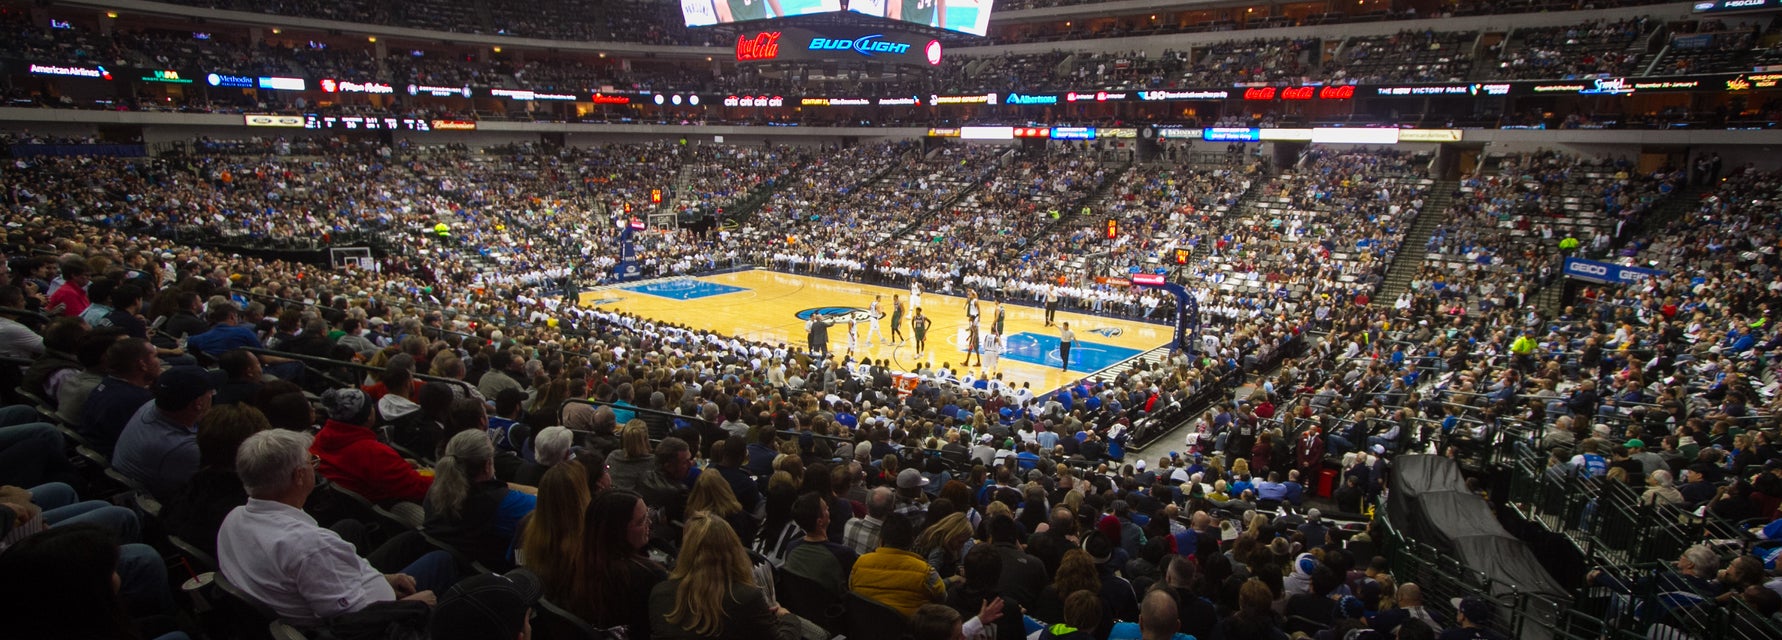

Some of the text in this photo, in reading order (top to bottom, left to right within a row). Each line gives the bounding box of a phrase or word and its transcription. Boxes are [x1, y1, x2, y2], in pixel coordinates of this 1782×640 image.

[736, 31, 781, 61] Coca-Cola
[808, 38, 910, 53] BUD LIGHT
[30, 64, 100, 77] American Airlines
[220, 75, 252, 83] Methodist
[1244, 87, 1276, 100] Coca-Cola
[1281, 86, 1315, 99] Coca-Cola
[1320, 85, 1356, 99] Coca-Cola
[1020, 95, 1057, 104] Albertsons
[1570, 262, 1607, 275] GEICO
